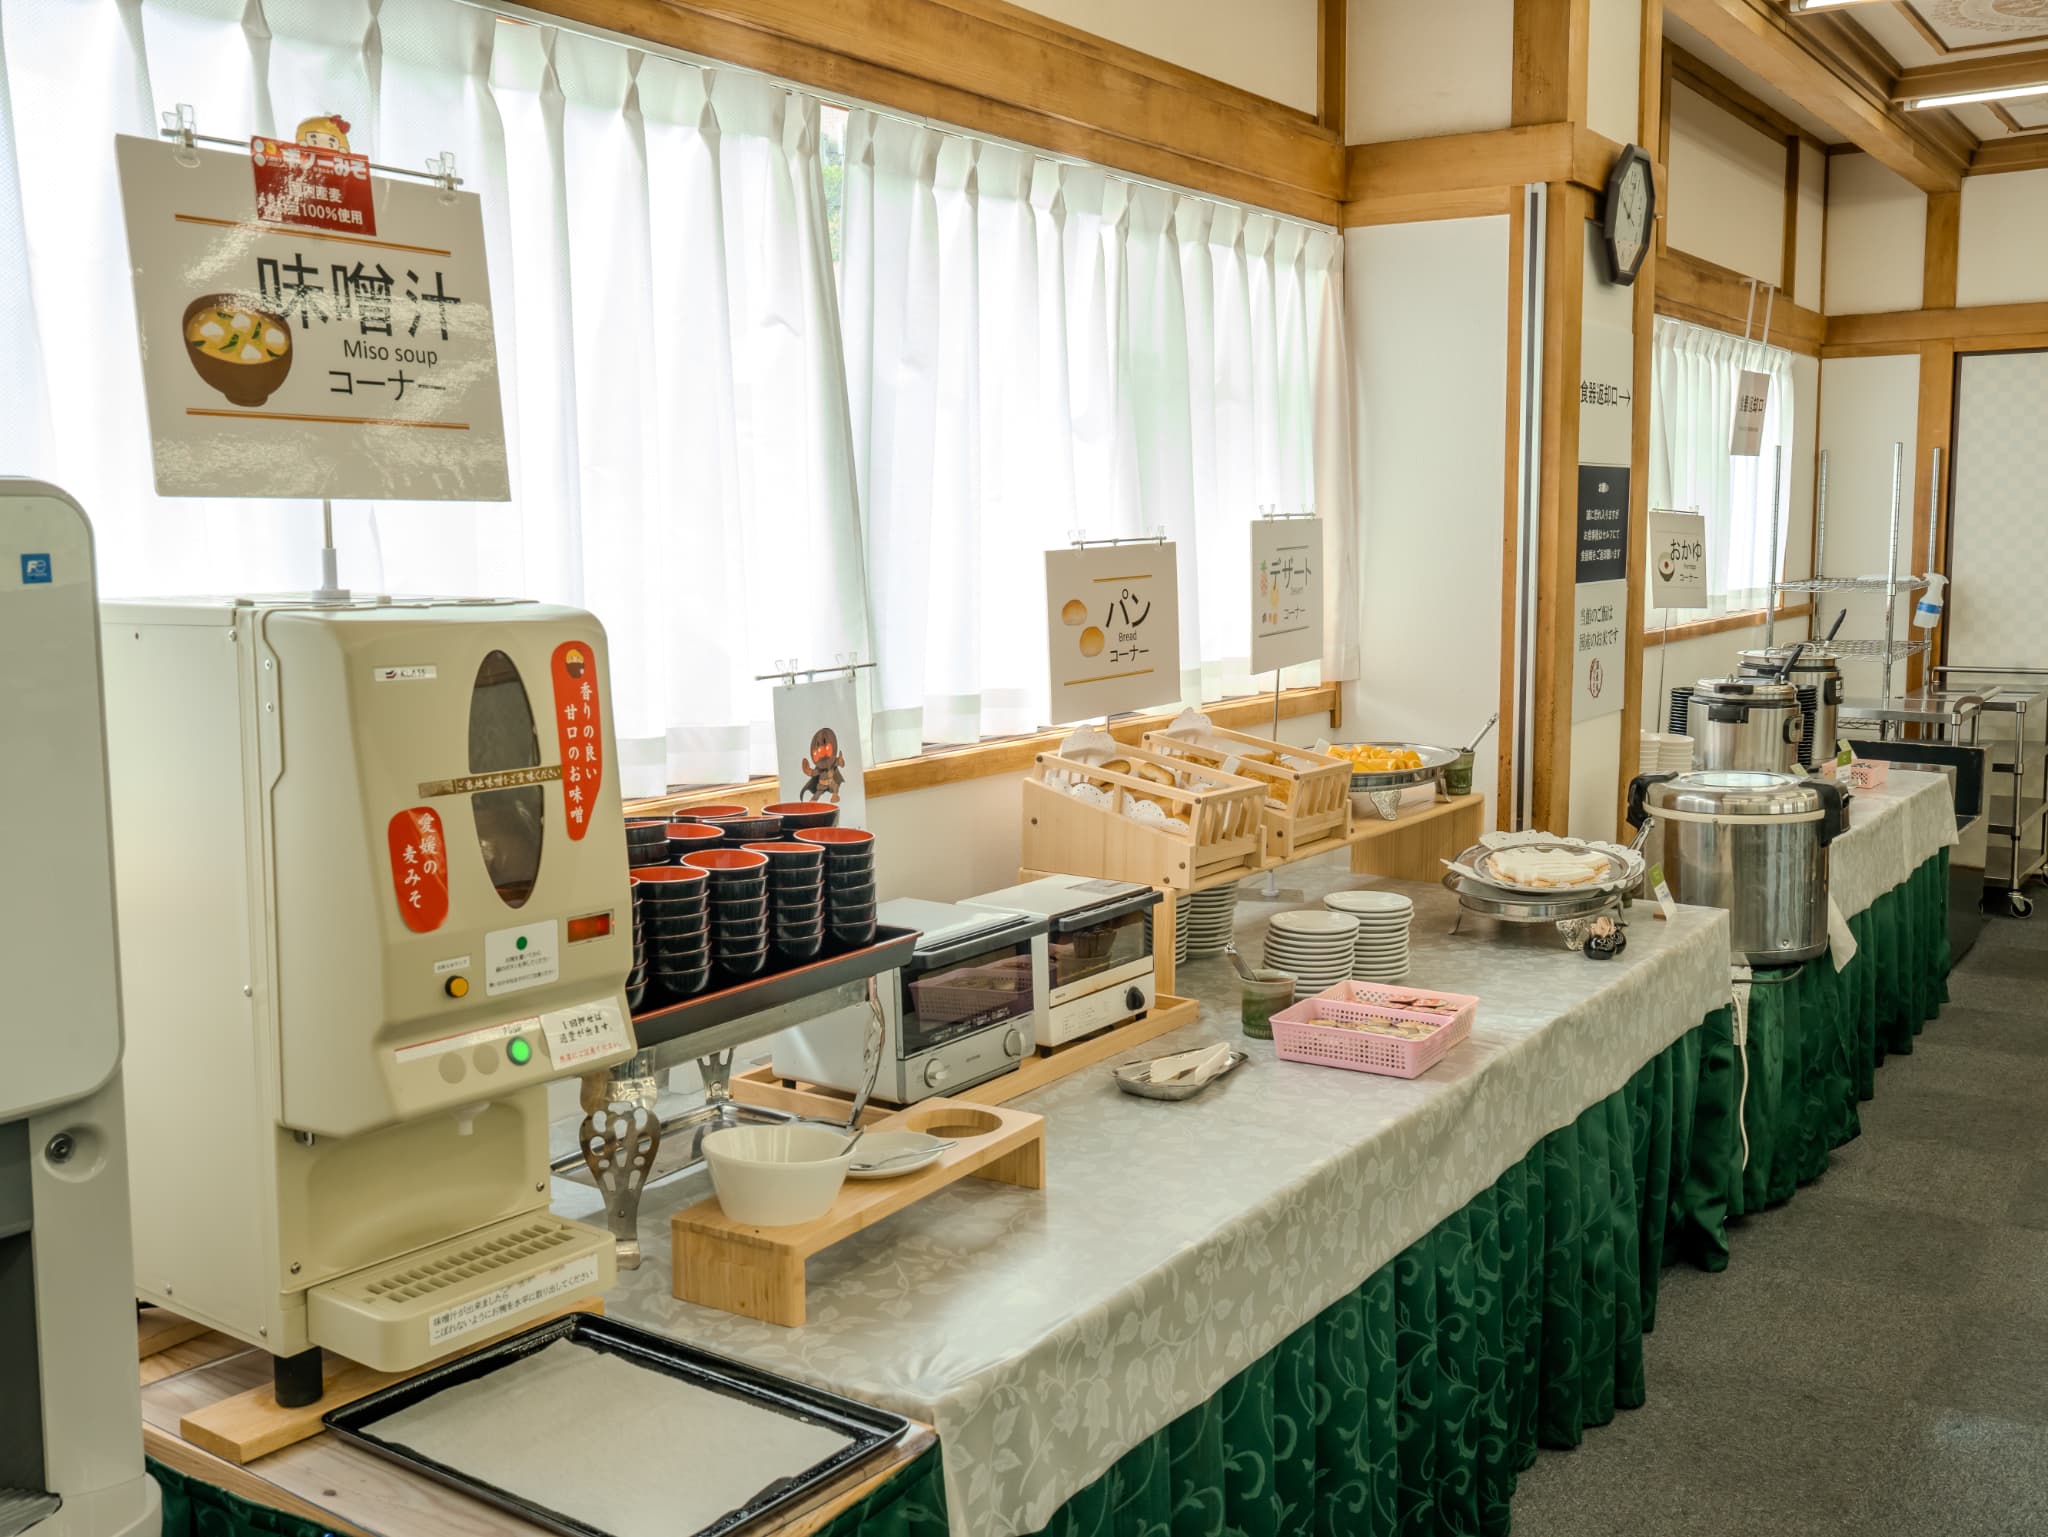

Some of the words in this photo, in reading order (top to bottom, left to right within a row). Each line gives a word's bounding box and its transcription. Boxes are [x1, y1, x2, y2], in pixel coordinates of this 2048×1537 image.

[257, 253, 461, 341] 味噌汁
[343, 339, 390, 362] Miso
[395, 347, 439, 367] soup
[329, 369, 447, 401] コーナー
[1580, 380, 1618, 406] 食器返却口
[1670, 538, 1702, 562] おかゆ
[1269, 556, 1312, 591] デザート
[1679, 573, 1700, 583] コーナー
[1105, 588, 1151, 628] パン
[1283, 603, 1306, 621] コーナー
[1118, 632, 1138, 643] Bread
[1110, 645, 1150, 663] コーナー
[580, 682, 598, 780] 香りの良い
[564, 704, 585, 824] 甘口のお味噌
[417, 812, 438, 874] 愛媛の
[402, 845, 423, 909] 麦みそ
